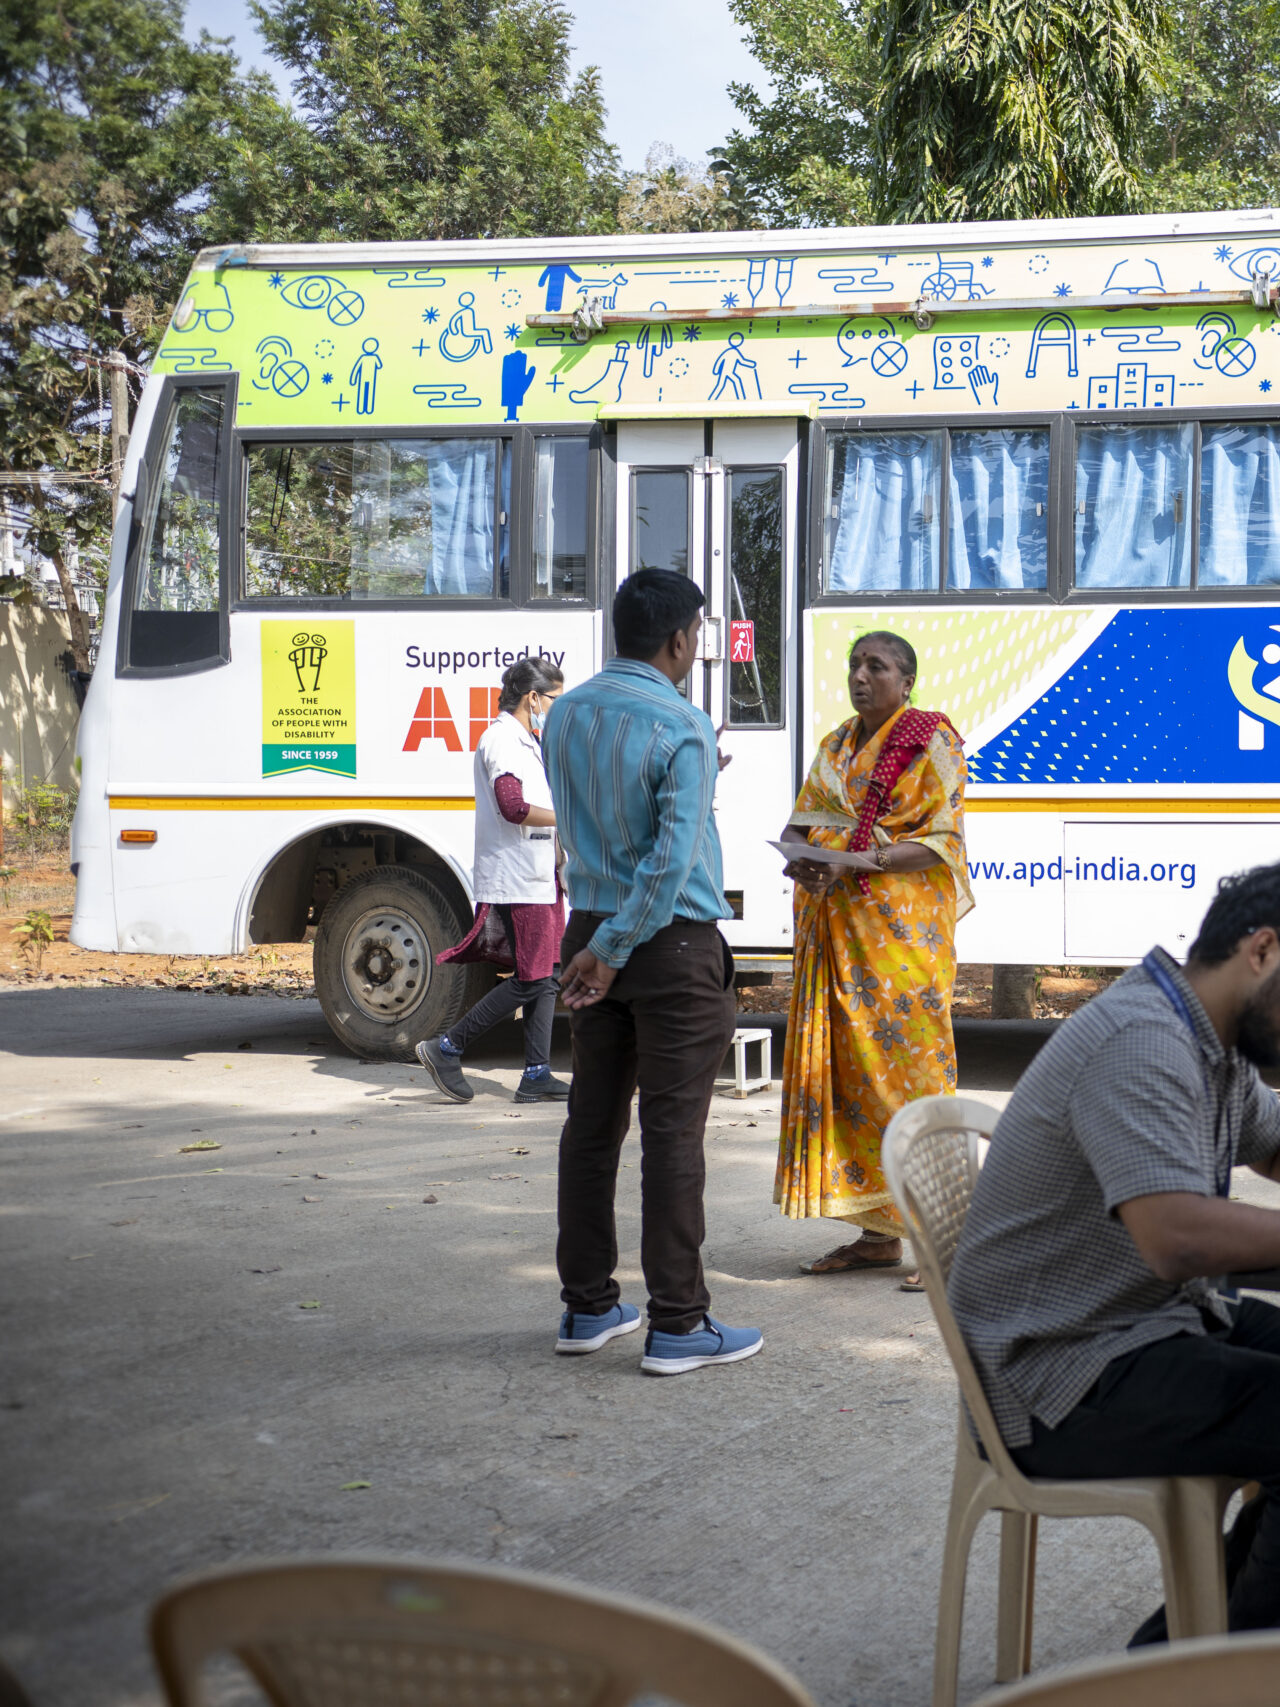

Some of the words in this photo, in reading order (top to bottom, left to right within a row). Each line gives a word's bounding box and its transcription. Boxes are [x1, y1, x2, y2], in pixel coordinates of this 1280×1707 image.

[300, 697, 319, 705] THE
[277, 708, 342, 716] ASSOCIATION
[271, 719, 284, 727] OF
[286, 719, 320, 727] PEOPLE
[322, 719, 348, 727] WITH
[281, 750, 312, 760] SINCE
[313, 750, 339, 760] 1959
